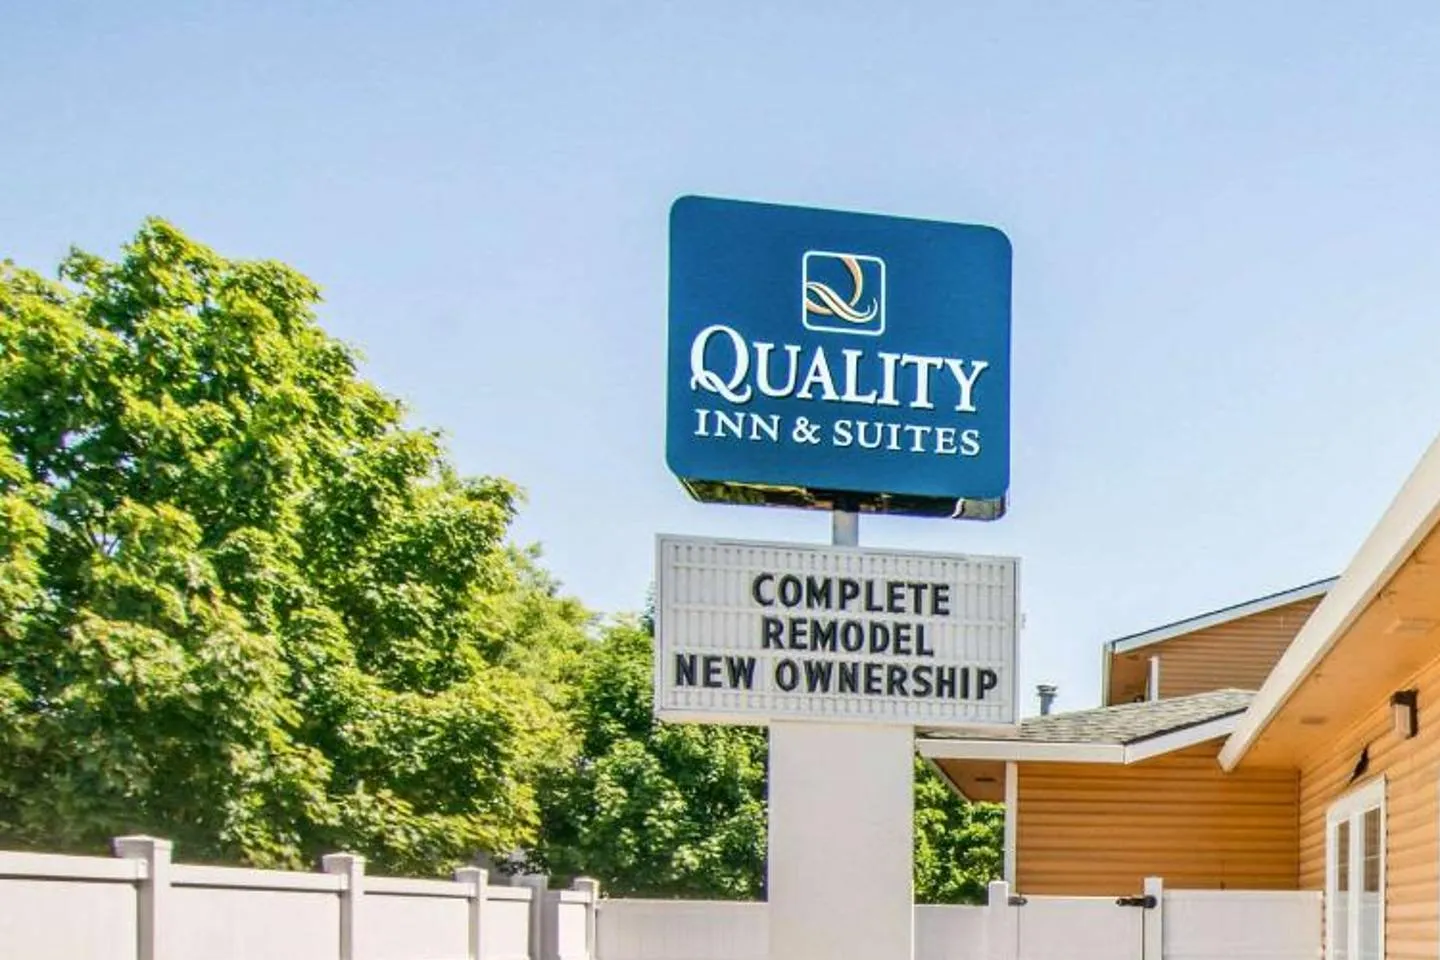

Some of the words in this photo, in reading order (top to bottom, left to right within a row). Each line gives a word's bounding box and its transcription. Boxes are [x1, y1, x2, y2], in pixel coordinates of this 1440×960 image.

[690, 324, 989, 413] QUALITY
[694, 408, 781, 443] INN
[791, 415, 822, 445] &
[832, 419, 982, 457] SUITES
[751, 572, 951, 616] COMPLETE
[761, 615, 935, 657] REMODEL
[674, 653, 757, 689] NEW
[774, 657, 998, 700] OWNERSHIP
